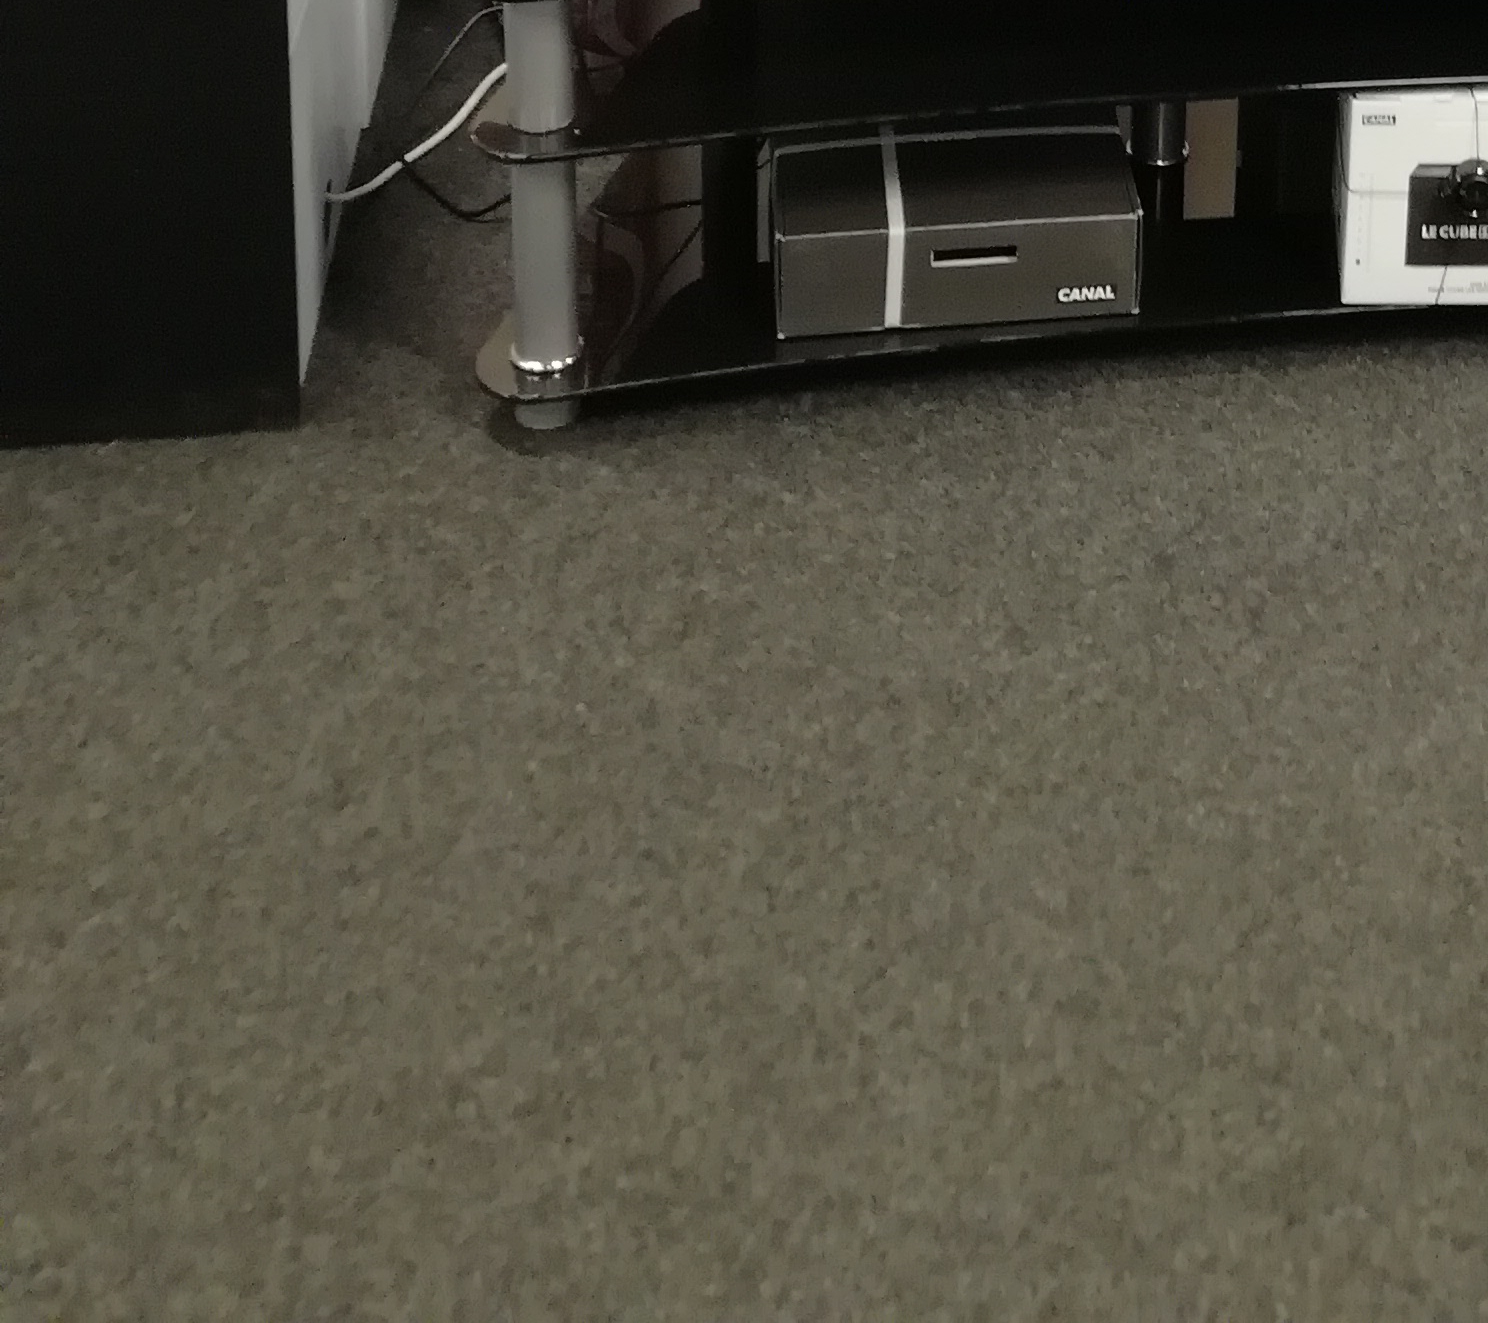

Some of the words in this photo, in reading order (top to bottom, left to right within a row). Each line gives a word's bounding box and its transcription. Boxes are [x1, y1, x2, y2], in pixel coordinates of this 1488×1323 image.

[1421, 223, 1437, 240] LE
[1438, 223, 1477, 240] CUBE
[1057, 284, 1116, 302] CANAL
